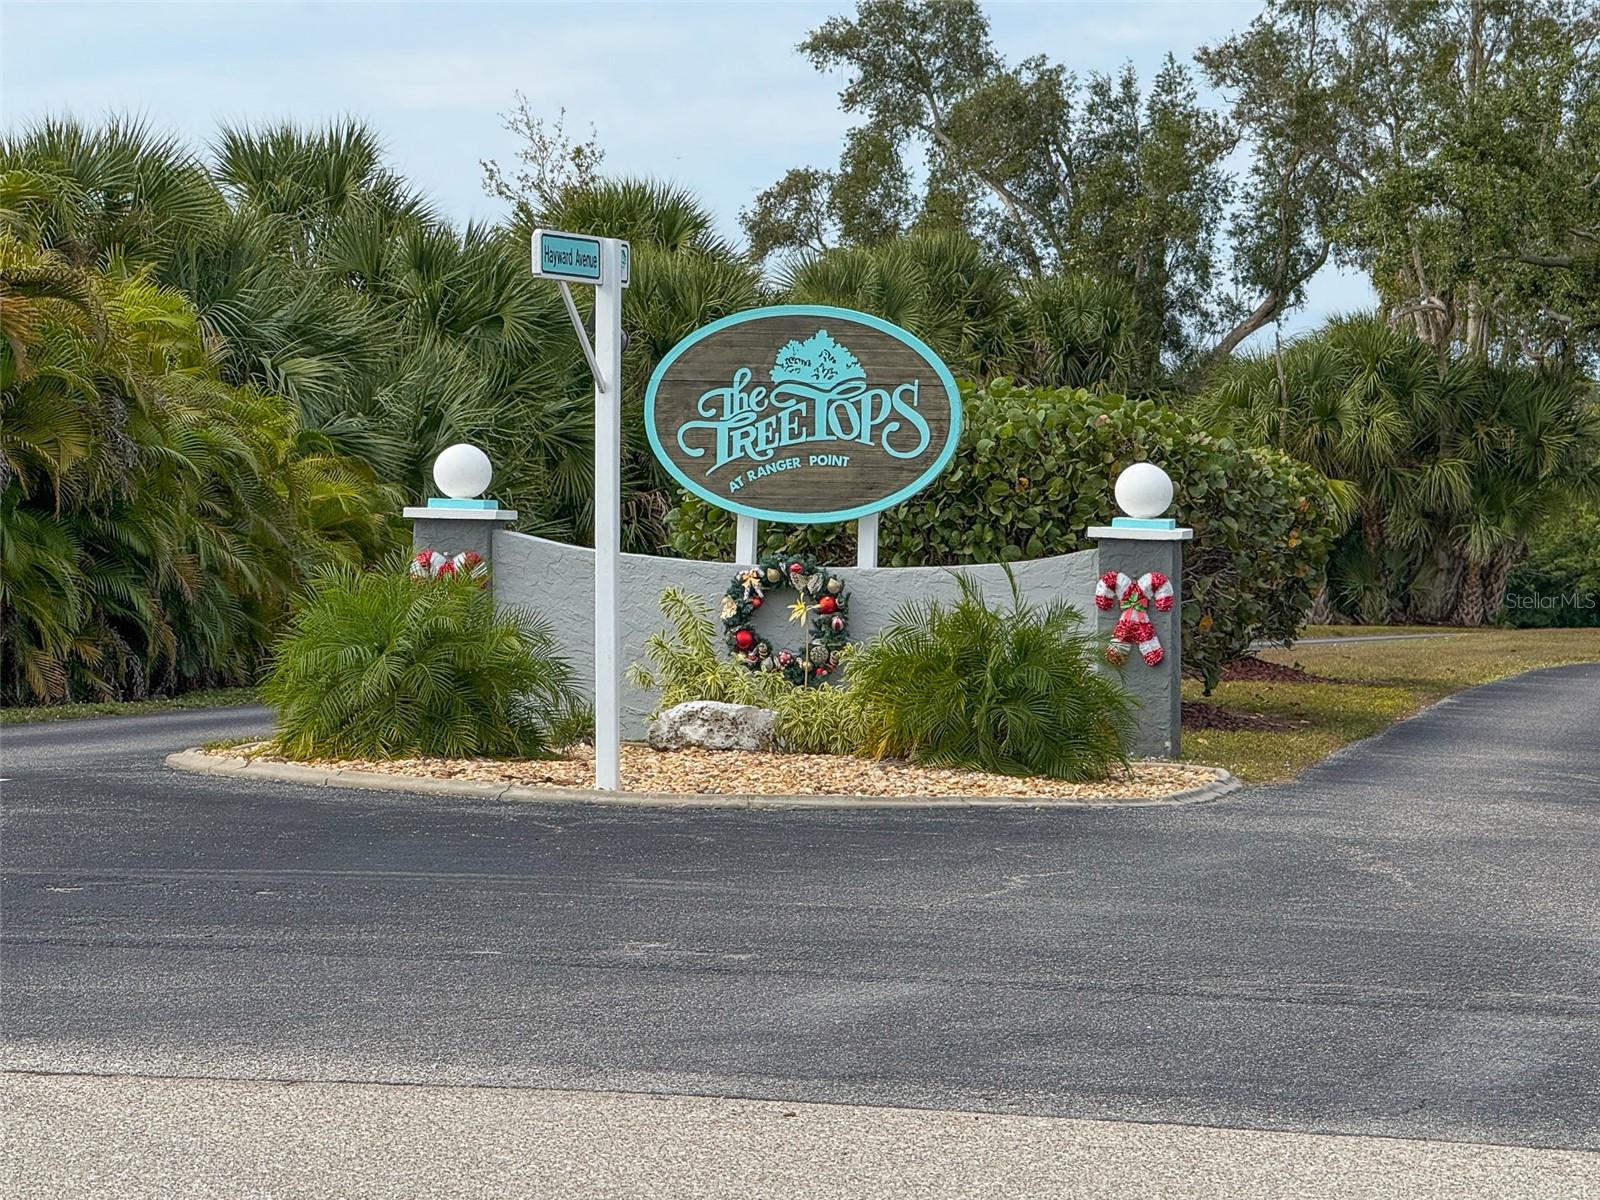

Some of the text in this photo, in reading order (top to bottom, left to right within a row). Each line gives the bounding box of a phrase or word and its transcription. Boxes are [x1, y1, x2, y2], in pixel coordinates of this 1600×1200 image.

[544, 244, 598, 269] Hayward Avenue
[697, 367, 769, 421] The
[728, 454, 850, 494] AT RANGER POINT
